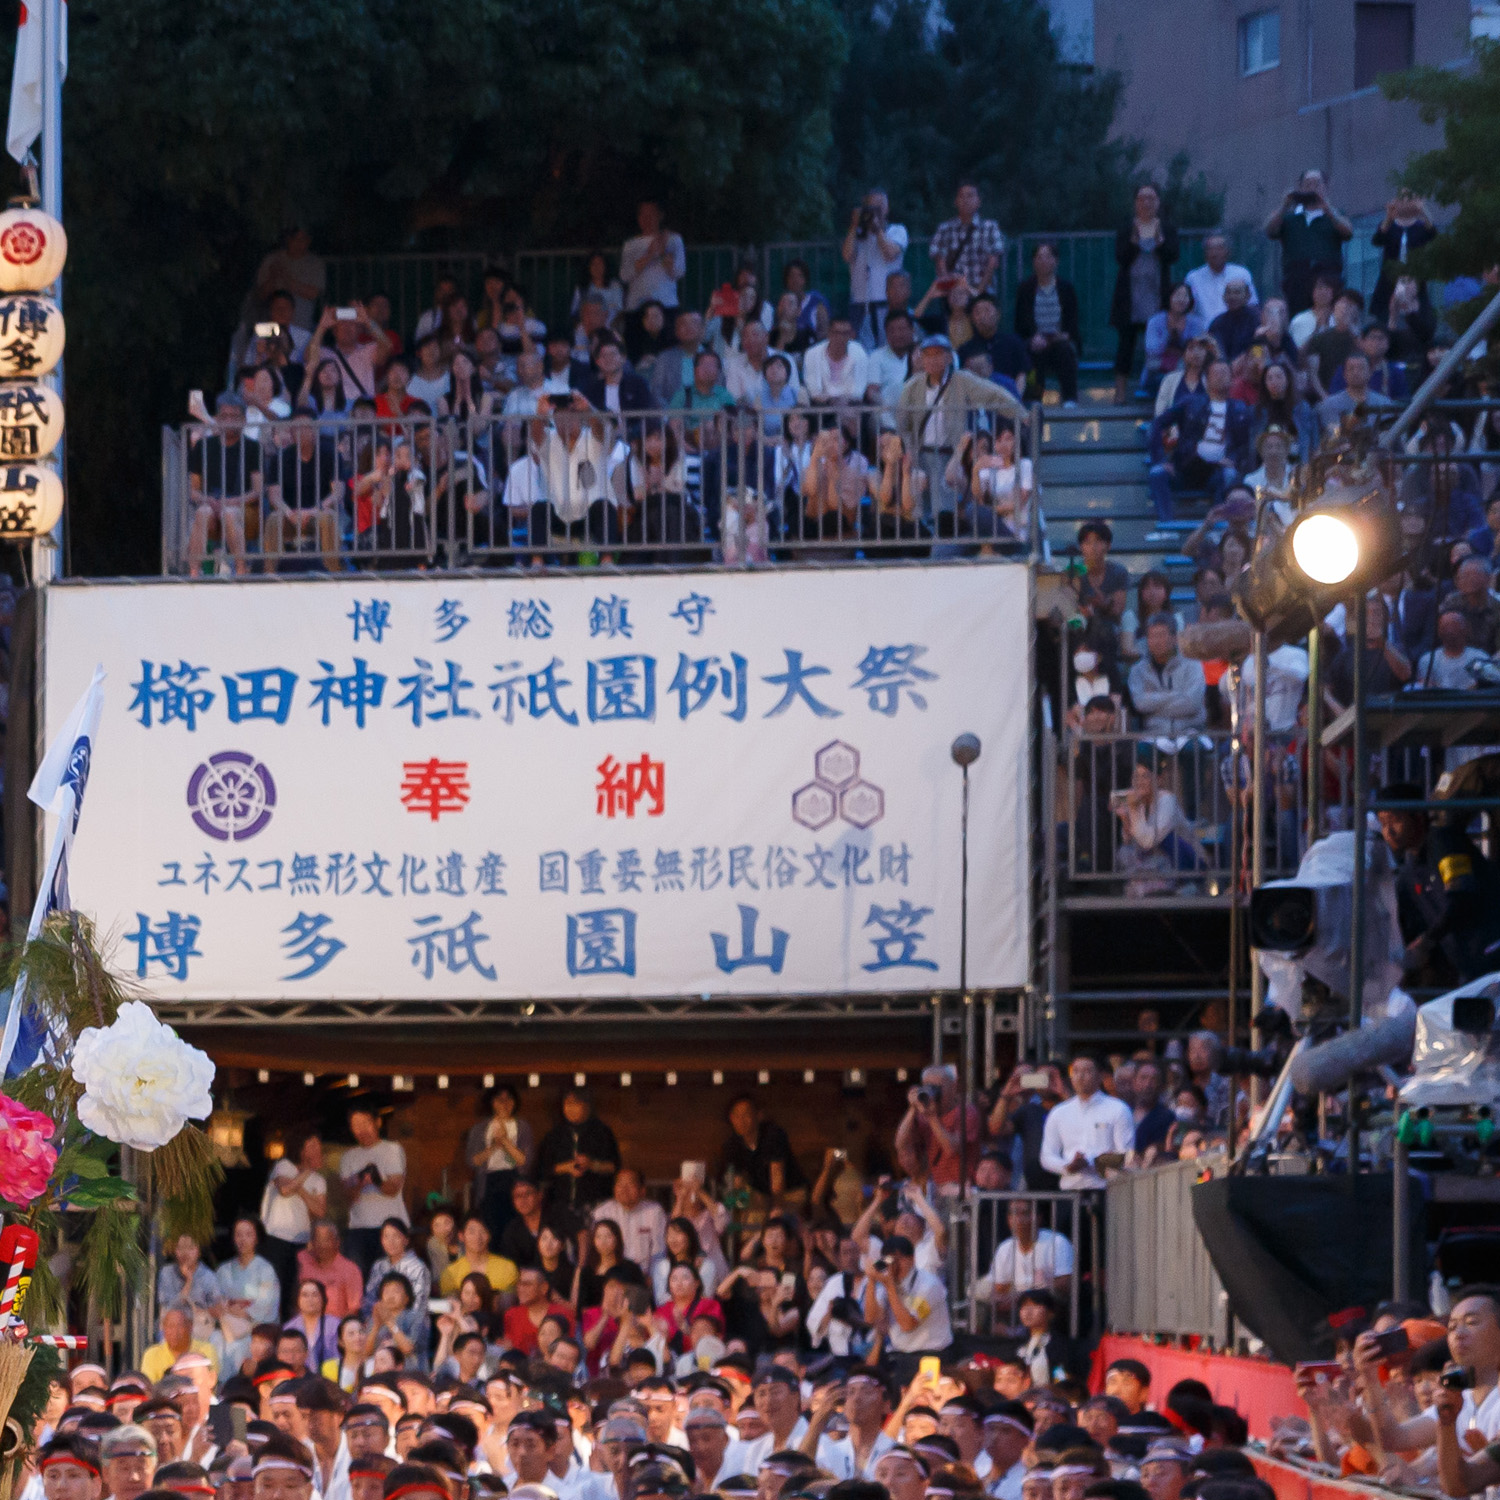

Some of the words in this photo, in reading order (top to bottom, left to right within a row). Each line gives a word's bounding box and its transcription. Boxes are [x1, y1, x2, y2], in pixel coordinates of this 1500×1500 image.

[347, 591, 718, 643] 博多総鎮守
[127, 643, 941, 731] 櫛田神社祇園例大祭
[157, 850, 509, 898] ユネスコ無形文化遺産
[538, 844, 913, 897] 国重要無形民俗文化財
[124, 901, 940, 981] 博多祇園山笠
